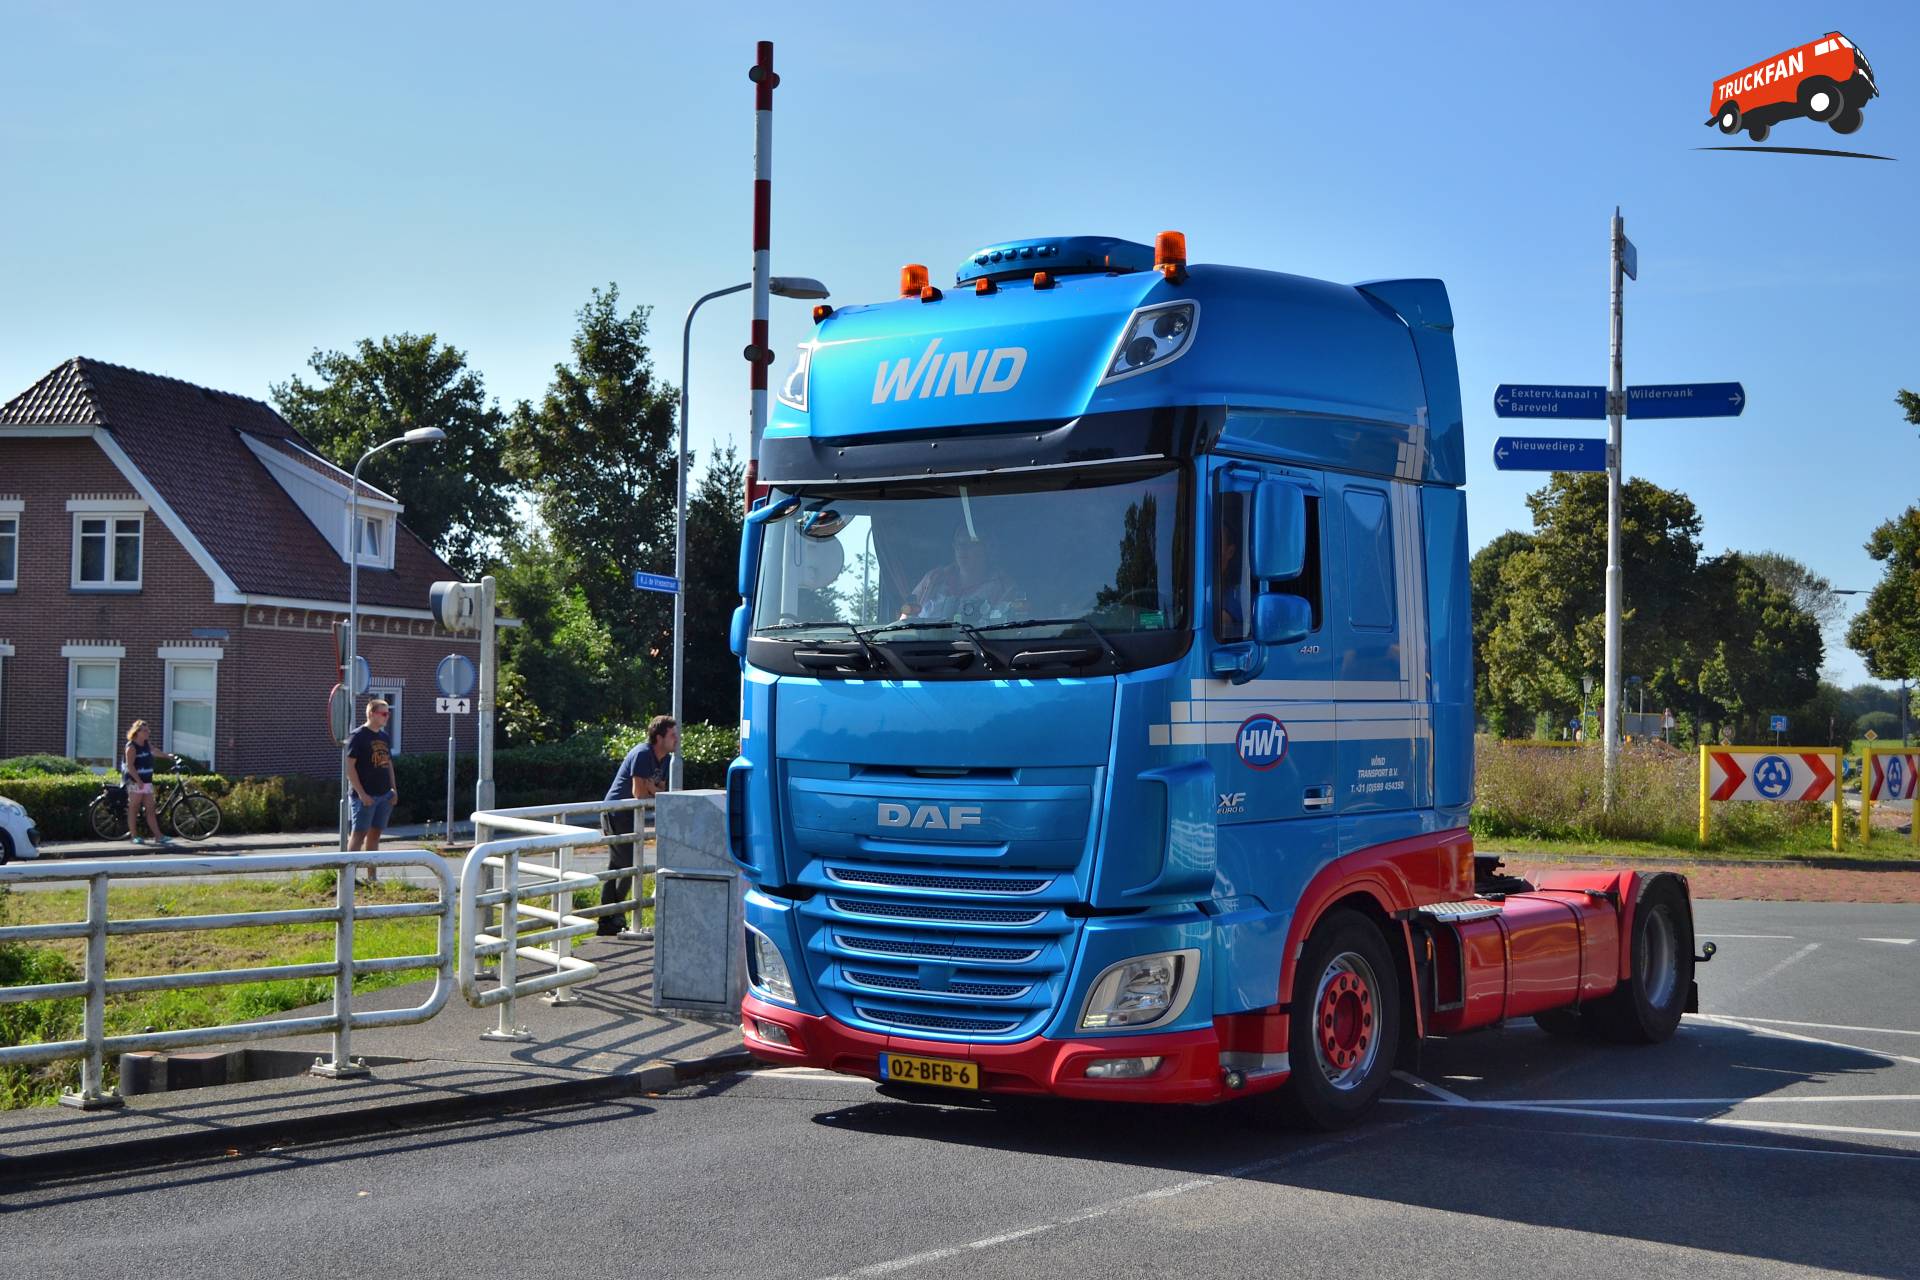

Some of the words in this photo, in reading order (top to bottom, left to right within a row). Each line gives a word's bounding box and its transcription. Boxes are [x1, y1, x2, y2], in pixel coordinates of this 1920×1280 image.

[872, 338, 1028, 405] WIND
[1511, 389, 1590, 400] Eexterv.kanaal
[1630, 388, 1694, 399] Wildervank
[1511, 402, 1558, 413] Bareveld
[1512, 440, 1576, 453] Nieuwediep
[1578, 443, 1585, 451] 2
[1300, 645, 1320, 655] 440
[1240, 721, 1286, 759] HWT
[1358, 768, 1388, 778] TRANSPORT
[1218, 792, 1246, 807] XF
[877, 802, 982, 830] DAF
[891, 1058, 970, 1084] 02-BFB-6
